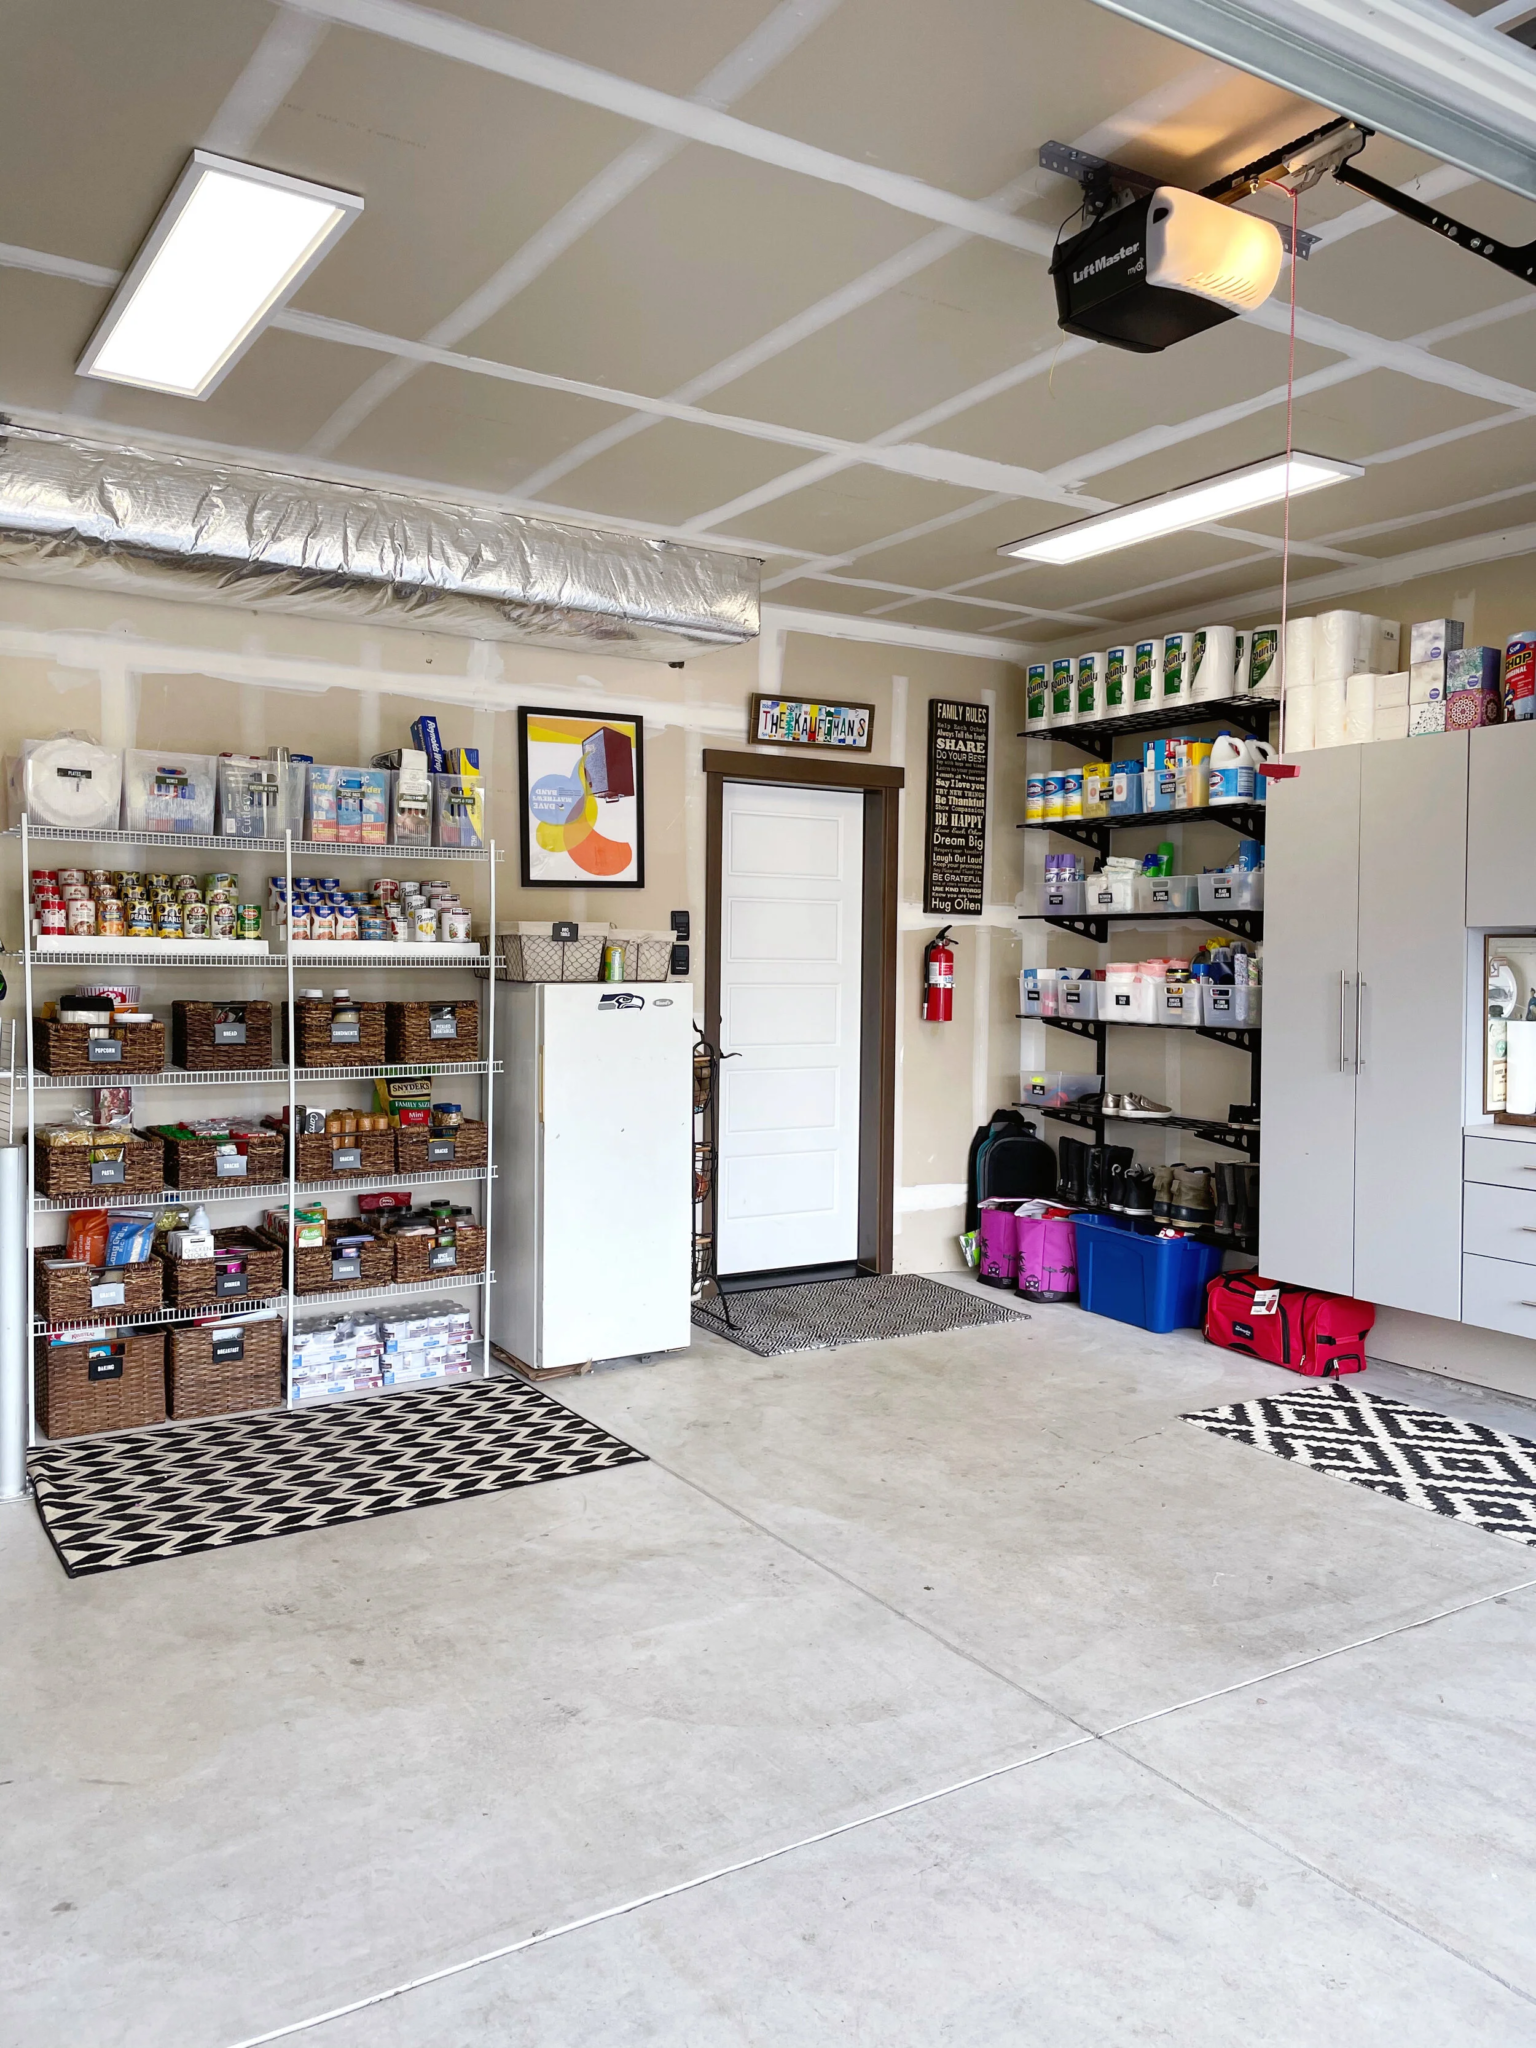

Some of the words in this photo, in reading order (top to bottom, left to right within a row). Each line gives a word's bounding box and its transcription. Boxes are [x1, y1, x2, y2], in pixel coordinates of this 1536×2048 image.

[1073, 242, 1140, 284] LiftMaster
[1105, 665, 1129, 684] Bounty
[1133, 659, 1158, 679] Bounty
[1051, 674, 1075, 694] Bounty
[937, 702, 963, 721] FAMILY
[966, 706, 987, 724] RULES
[762, 710, 786, 734] THE
[426, 720, 439, 753] Reynolds
[434, 752, 444, 773] Wrap
[936, 738, 986, 754] SHARE
[936, 778, 950, 788] Say
[951, 780, 955, 788] I
[956, 780, 971, 789] love
[971, 783, 985, 791] you
[935, 795, 947, 805] Be
[948, 796, 985, 808] Thankful
[241, 794, 253, 835] Cutlery
[935, 812, 949, 826] BE
[951, 814, 984, 829] HAPPY
[934, 832, 966, 846] Dream
[968, 835, 984, 851] Big
[933, 853, 953, 864] Laugh
[954, 854, 966, 863] Out
[967, 855, 983, 864] Loud
[932, 898, 952, 913] Hug
[954, 898, 981, 911] Often
[393, 1082, 430, 1092] SNYDER'S
[185, 1246, 212, 1254] CHICKEN
[217, 1347, 240, 1355] BREAKFAST
[98, 1364, 115, 1372] BAKING
